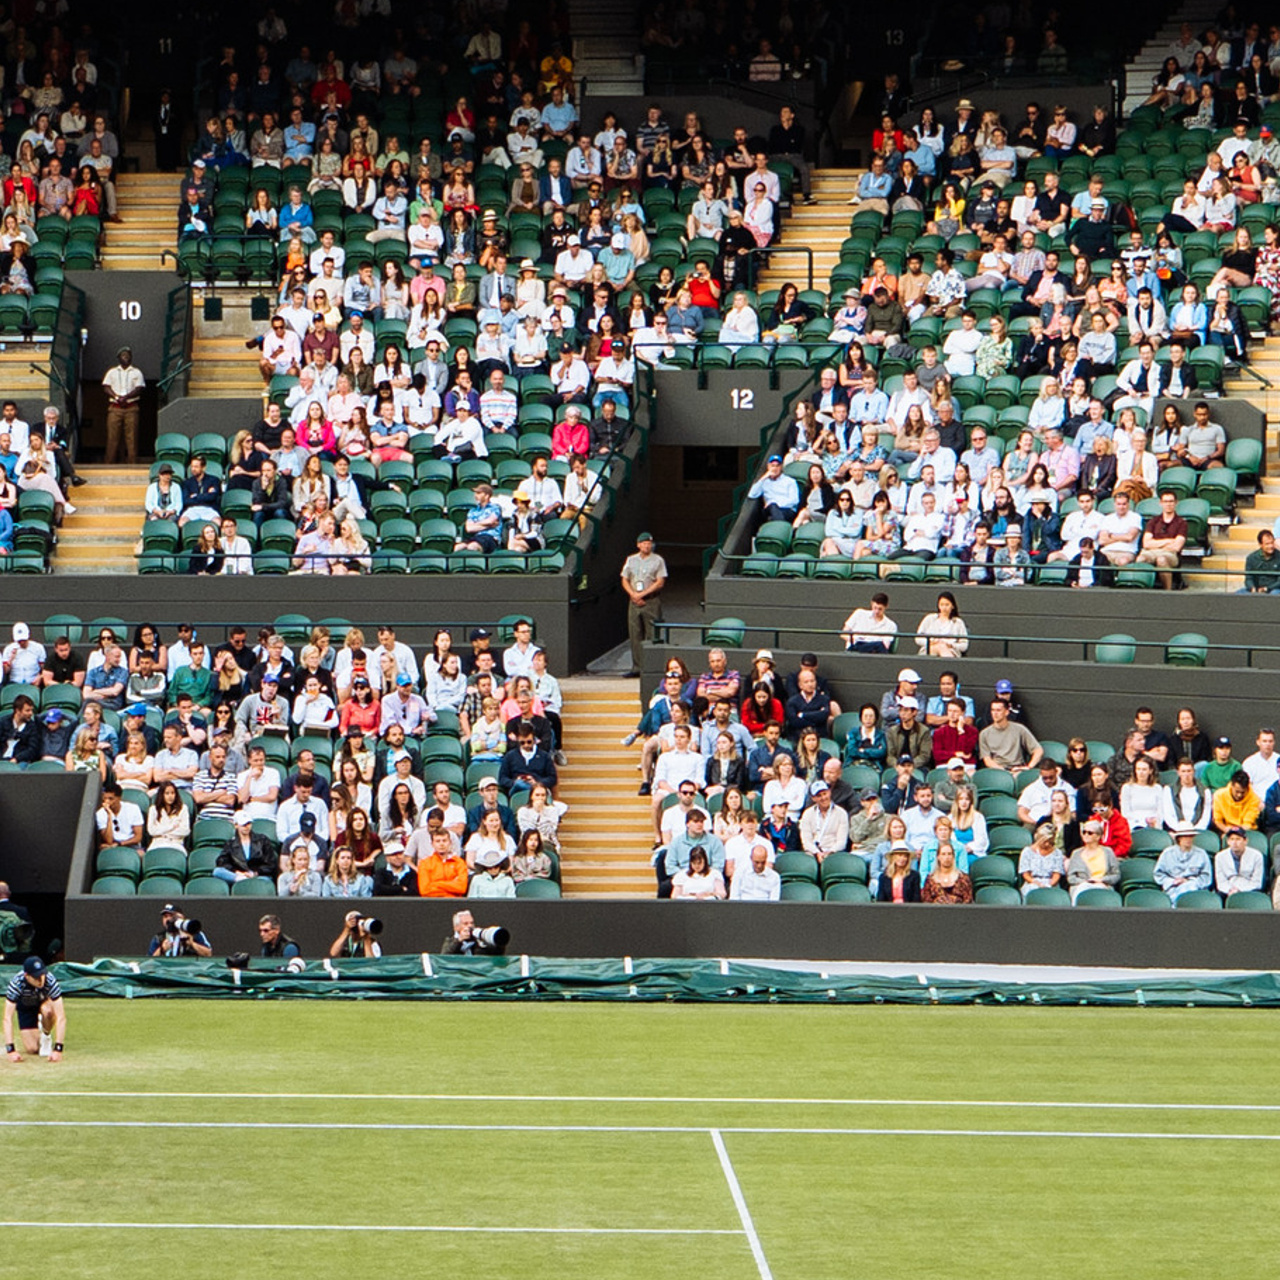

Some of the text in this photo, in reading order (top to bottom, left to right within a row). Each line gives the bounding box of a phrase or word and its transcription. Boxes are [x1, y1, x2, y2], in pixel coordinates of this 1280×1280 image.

[886, 29, 903, 45] 13
[159, 38, 172, 54] 11
[119, 301, 141, 320] 10
[730, 388, 754, 409] 12
